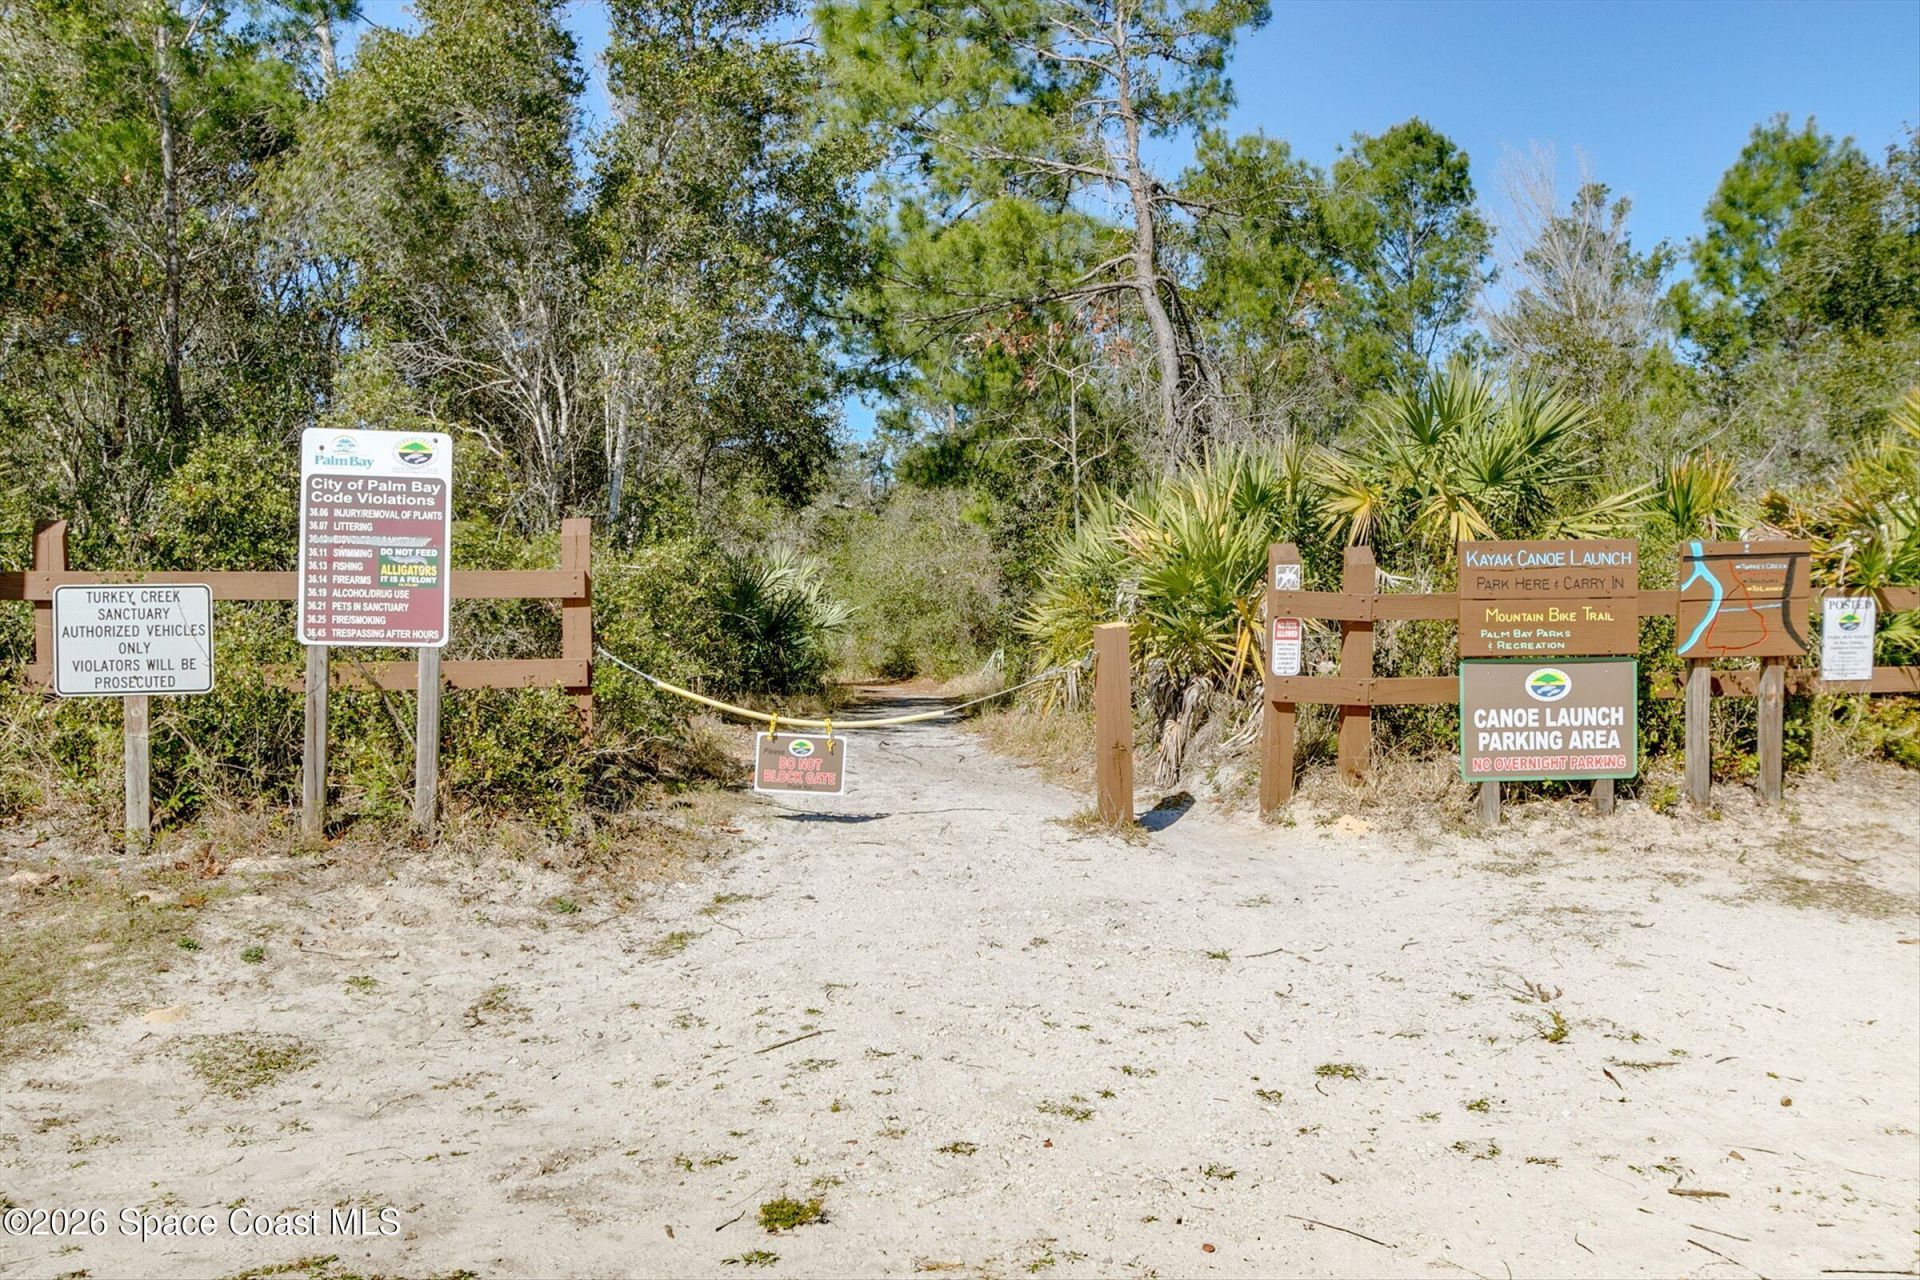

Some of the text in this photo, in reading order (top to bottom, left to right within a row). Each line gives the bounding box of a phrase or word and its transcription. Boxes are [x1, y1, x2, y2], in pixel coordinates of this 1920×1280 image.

[311, 478, 442, 495] City of Palm Bay
[311, 492, 435, 506] Code Violations
[309, 508, 443, 520] 36.06 INJURY/REMOVAL OF PLANTS
[309, 521, 373, 531] 36.07 LITTERING
[308, 548, 372, 558] 36.11 SWIMMING
[380, 548, 438, 557] DO NOT FEED
[1466, 549, 1632, 567] KAYAK CANOE LAUNCH
[308, 562, 363, 571] 36.13 FISHING
[380, 564, 437, 576] ALLIGATORS
[308, 575, 372, 585] 36.14 FIREARMS
[406, 576, 437, 584] FELONY
[1476, 576, 1509, 591] PARK
[1515, 577, 1550, 590] HERE
[1563, 576, 1606, 590] CARRY
[1612, 576, 1624, 589] IN
[86, 591, 181, 603] TURKEY CREEK
[308, 588, 410, 599] 36.19 ALCOHOL/DRUG USE
[307, 602, 409, 612] 36.21 PETS IN SANCTUARY
[1828, 600, 1872, 610] POSTED
[98, 608, 170, 620] SANCTUARY
[307, 615, 386, 625] 36.25 FIRE/SMOKING
[1485, 606, 1614, 622] MOUNTAIN BIKE TRAIL
[62, 624, 206, 638] AUTHORIZED VEHICLES
[307, 628, 439, 639] 36.45 TRESPASSING AFTER HOURS
[1480, 629, 1571, 638] PALM BAY PARKS
[118, 642, 151, 654] ONLY
[1497, 641, 1565, 650] RECREATION
[72, 658, 197, 672] VIOLATORS WILL BE
[95, 676, 176, 689] PROSECUTED
[1474, 706, 1624, 729] CANOE LAUNCH
[1478, 730, 1620, 751] PARKING AREA
[779, 757, 822, 771] DO NOT
[1473, 754, 1626, 771] NO OVERNIGHT PARKING
[763, 769, 836, 785] BLOCK GATE
